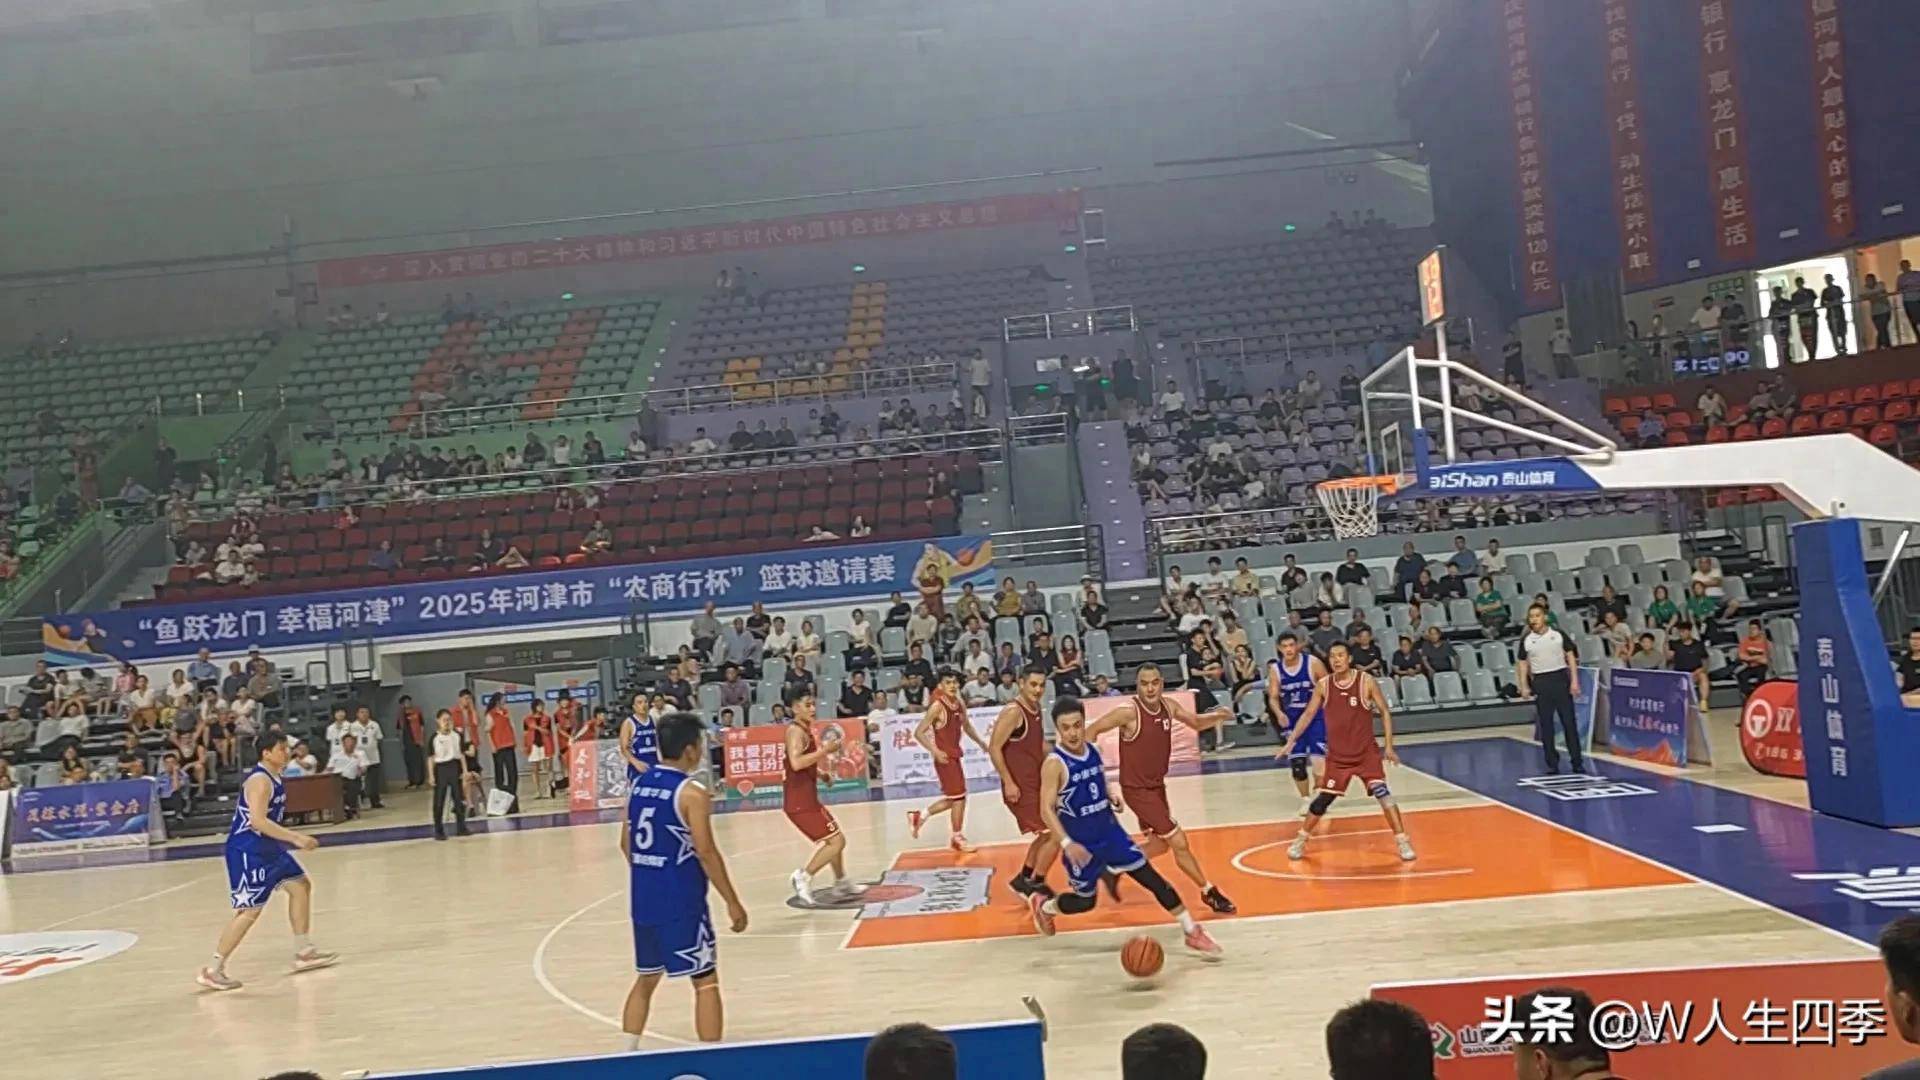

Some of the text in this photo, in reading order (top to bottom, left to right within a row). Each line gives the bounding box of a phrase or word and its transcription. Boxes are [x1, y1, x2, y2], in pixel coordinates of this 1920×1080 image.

[1718, 166, 1748, 247] 惠生活
[1502, 471, 1556, 486] 泰山体育
[139, 554, 896, 645] “鱼跃龙门 幸福河津” 2025年河津市 “农商行杯” 篮球邀请赛
[1816, 637, 1848, 777] 泰山体育
[1088, 782, 1099, 800] 9
[635, 807, 656, 850] 5
[251, 868, 265, 883] 10
